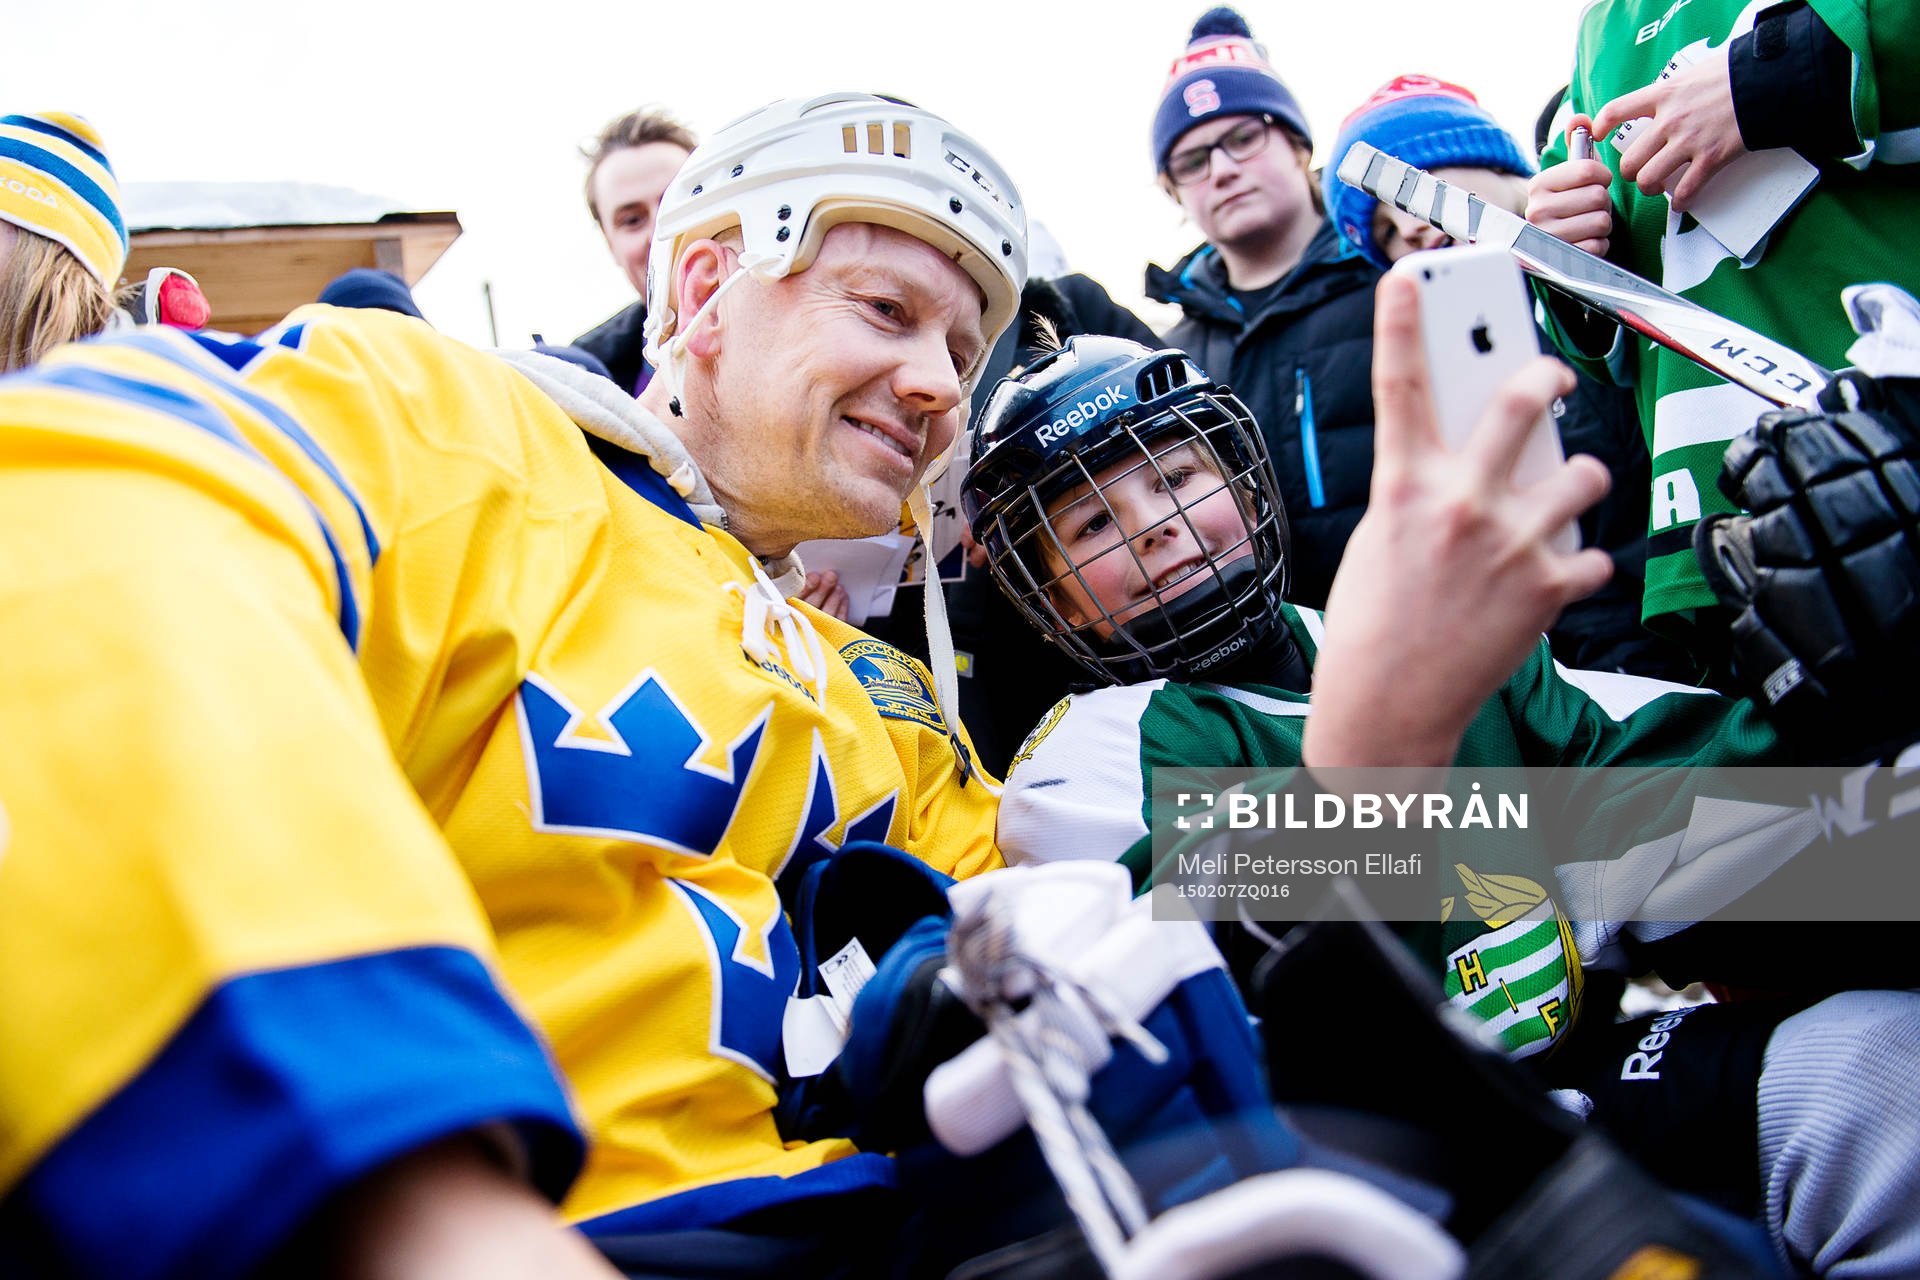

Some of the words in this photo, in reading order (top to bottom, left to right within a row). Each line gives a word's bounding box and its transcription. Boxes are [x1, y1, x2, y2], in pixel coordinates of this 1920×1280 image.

[1183, 79, 1221, 118] S
[1710, 338, 1812, 393] CCM
[1034, 384, 1129, 449] Reebok
